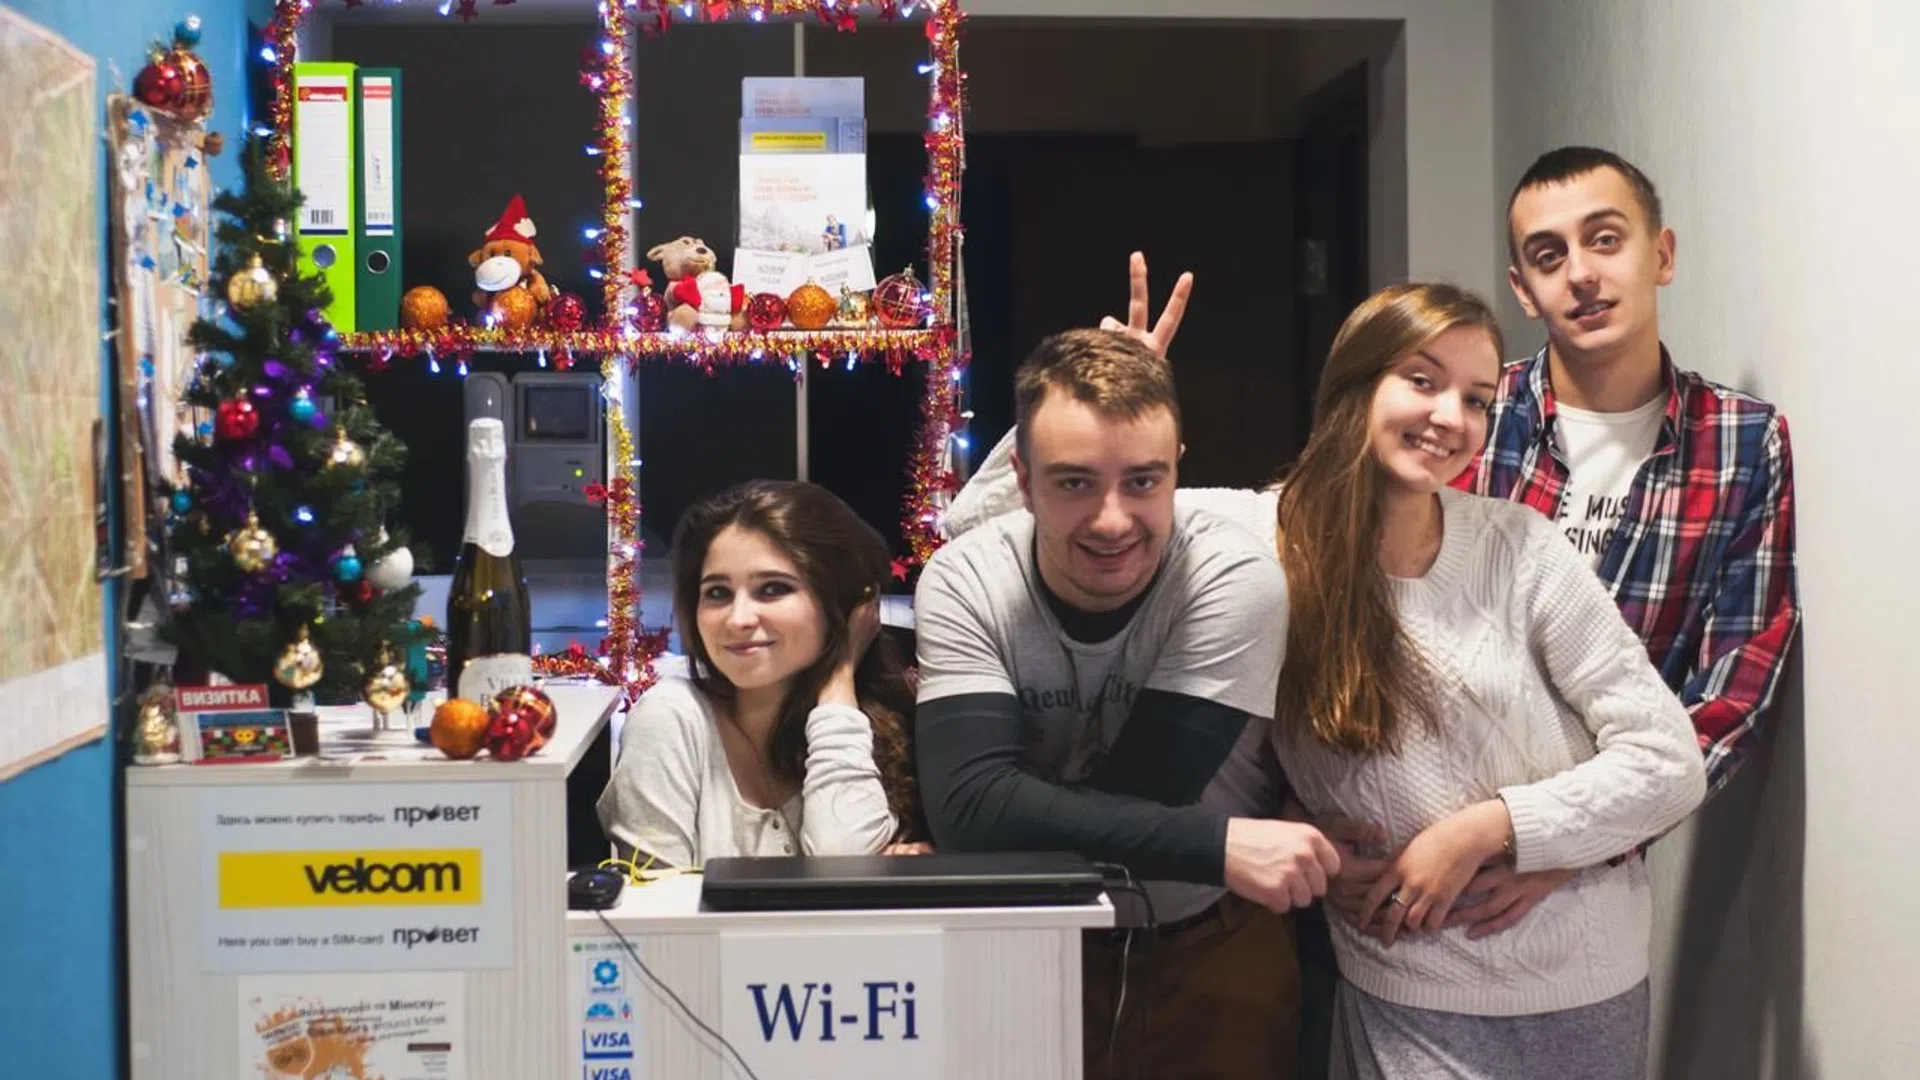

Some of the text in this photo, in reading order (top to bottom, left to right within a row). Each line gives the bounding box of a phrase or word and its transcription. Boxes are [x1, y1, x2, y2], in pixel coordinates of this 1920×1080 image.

[181, 689, 261, 706] ВИЗИТКА
[297, 813, 335, 829] купить
[338, 811, 386, 827] тарифы
[304, 857, 461, 894] velcom
[218, 936, 246, 947] Here
[250, 936, 271, 949] you
[274, 935, 293, 946] can
[297, 933, 318, 948] buy
[332, 932, 384, 946] SIM-card
[746, 982, 919, 1042] Wi-Fi
[373, 1019, 412, 1031] around
[414, 1015, 446, 1026] Minsk
[590, 1031, 631, 1048] VISA
[591, 1067, 633, 1080] VISA
